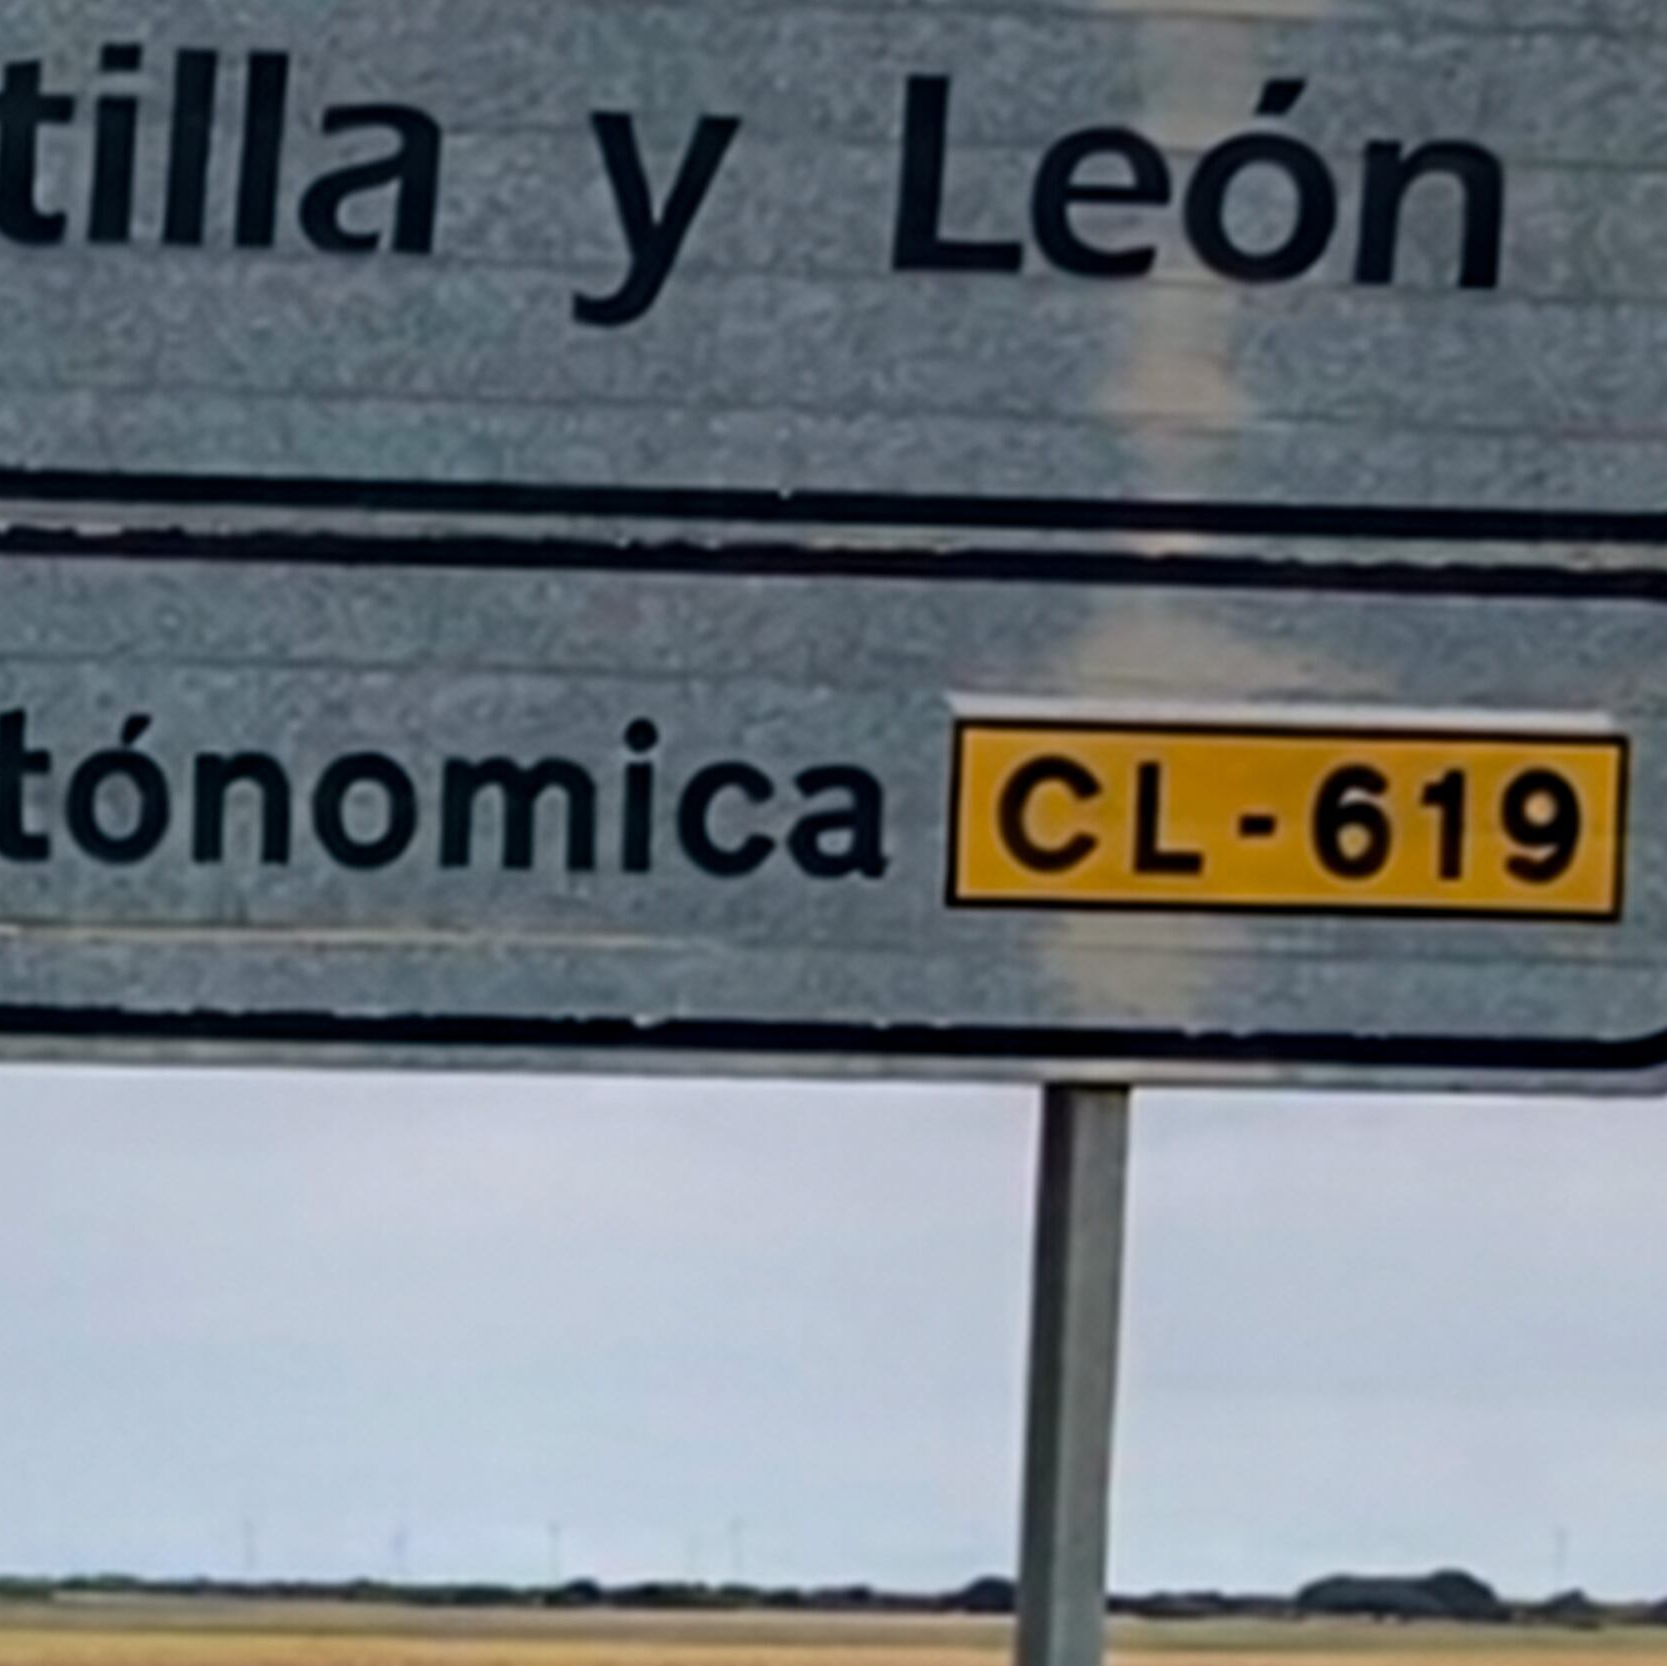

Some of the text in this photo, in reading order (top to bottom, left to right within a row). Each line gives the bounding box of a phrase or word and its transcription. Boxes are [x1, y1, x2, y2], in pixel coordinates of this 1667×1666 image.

[571, 109, 743, 329] y
[890, 72, 1506, 293] León
[997, 754, 1582, 886] CL-619
